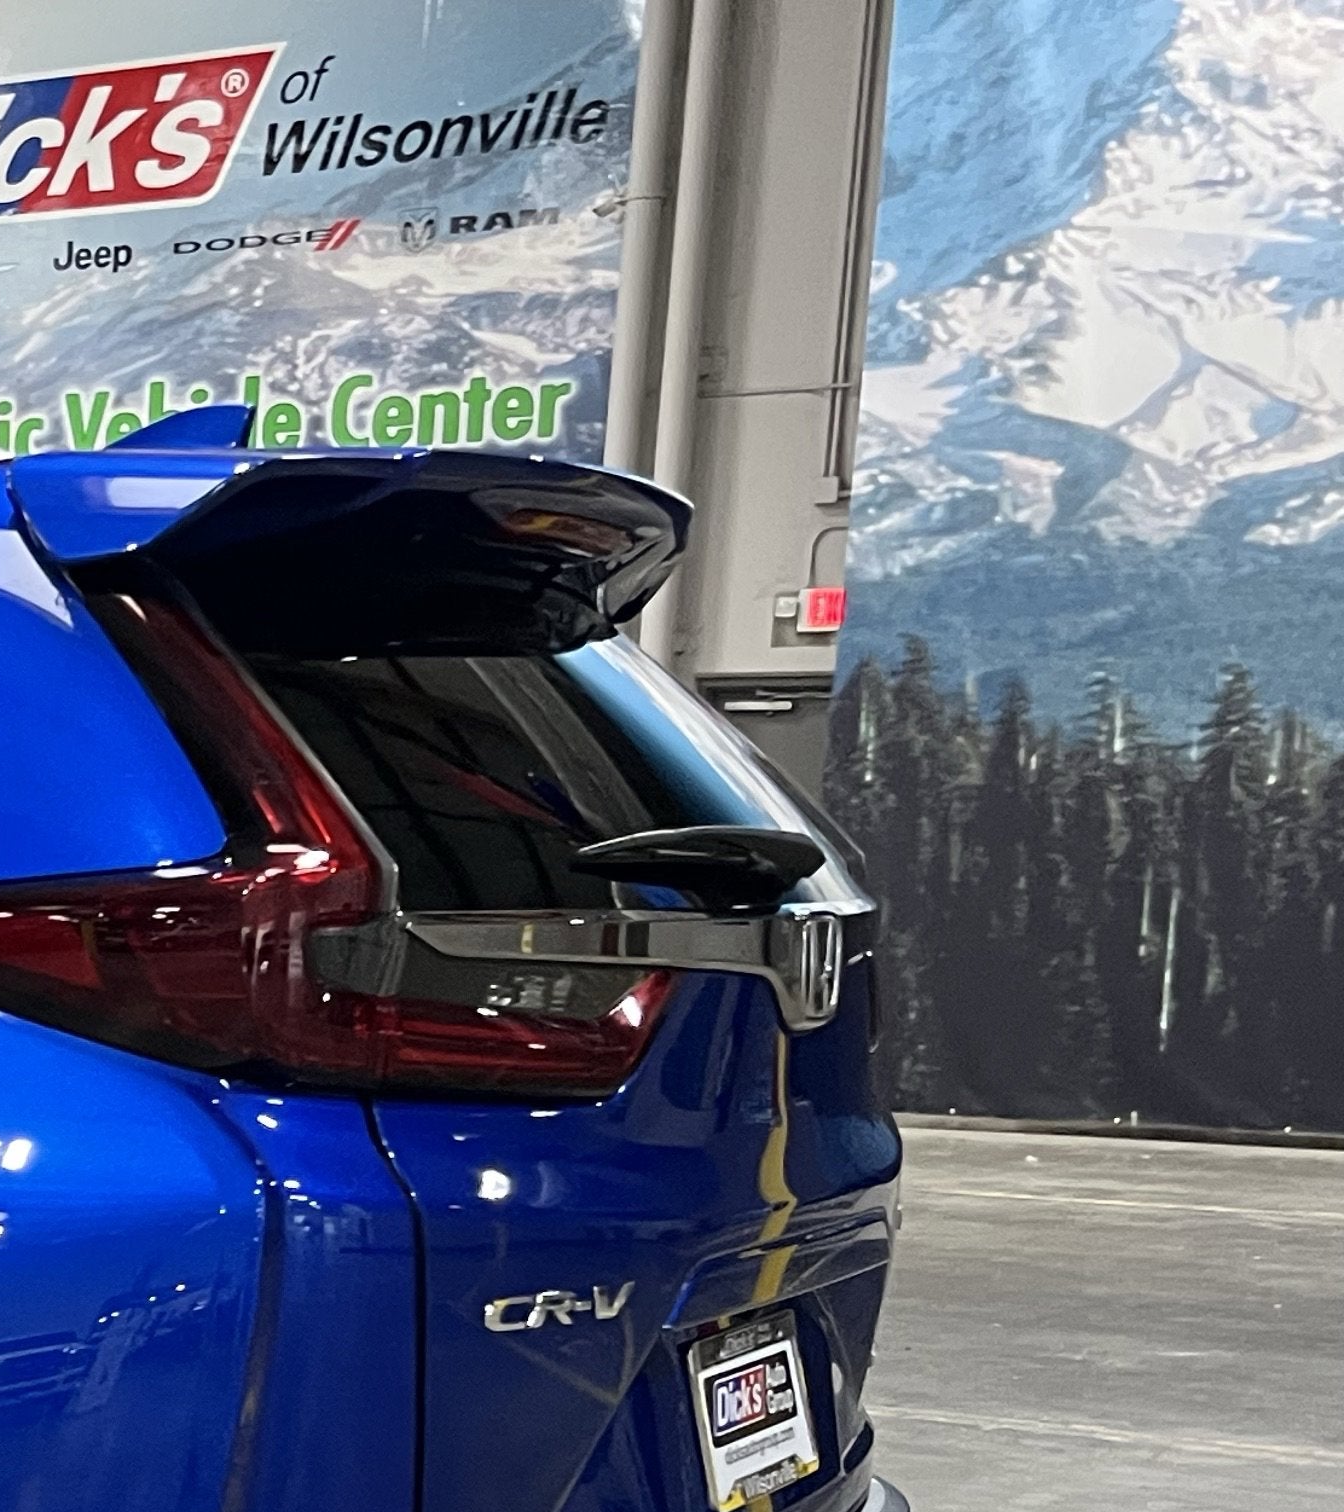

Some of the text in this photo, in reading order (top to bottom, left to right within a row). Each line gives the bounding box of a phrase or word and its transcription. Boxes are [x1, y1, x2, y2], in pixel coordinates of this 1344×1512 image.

[279, 55, 337, 105] of
[261, 87, 610, 177] Wilsonville
[172, 226, 332, 256] DODGE
[449, 205, 562, 235] RAM
[53, 240, 133, 273] Jeep
[331, 374, 572, 448] Center
[484, 1280, 636, 1332] CR-V
